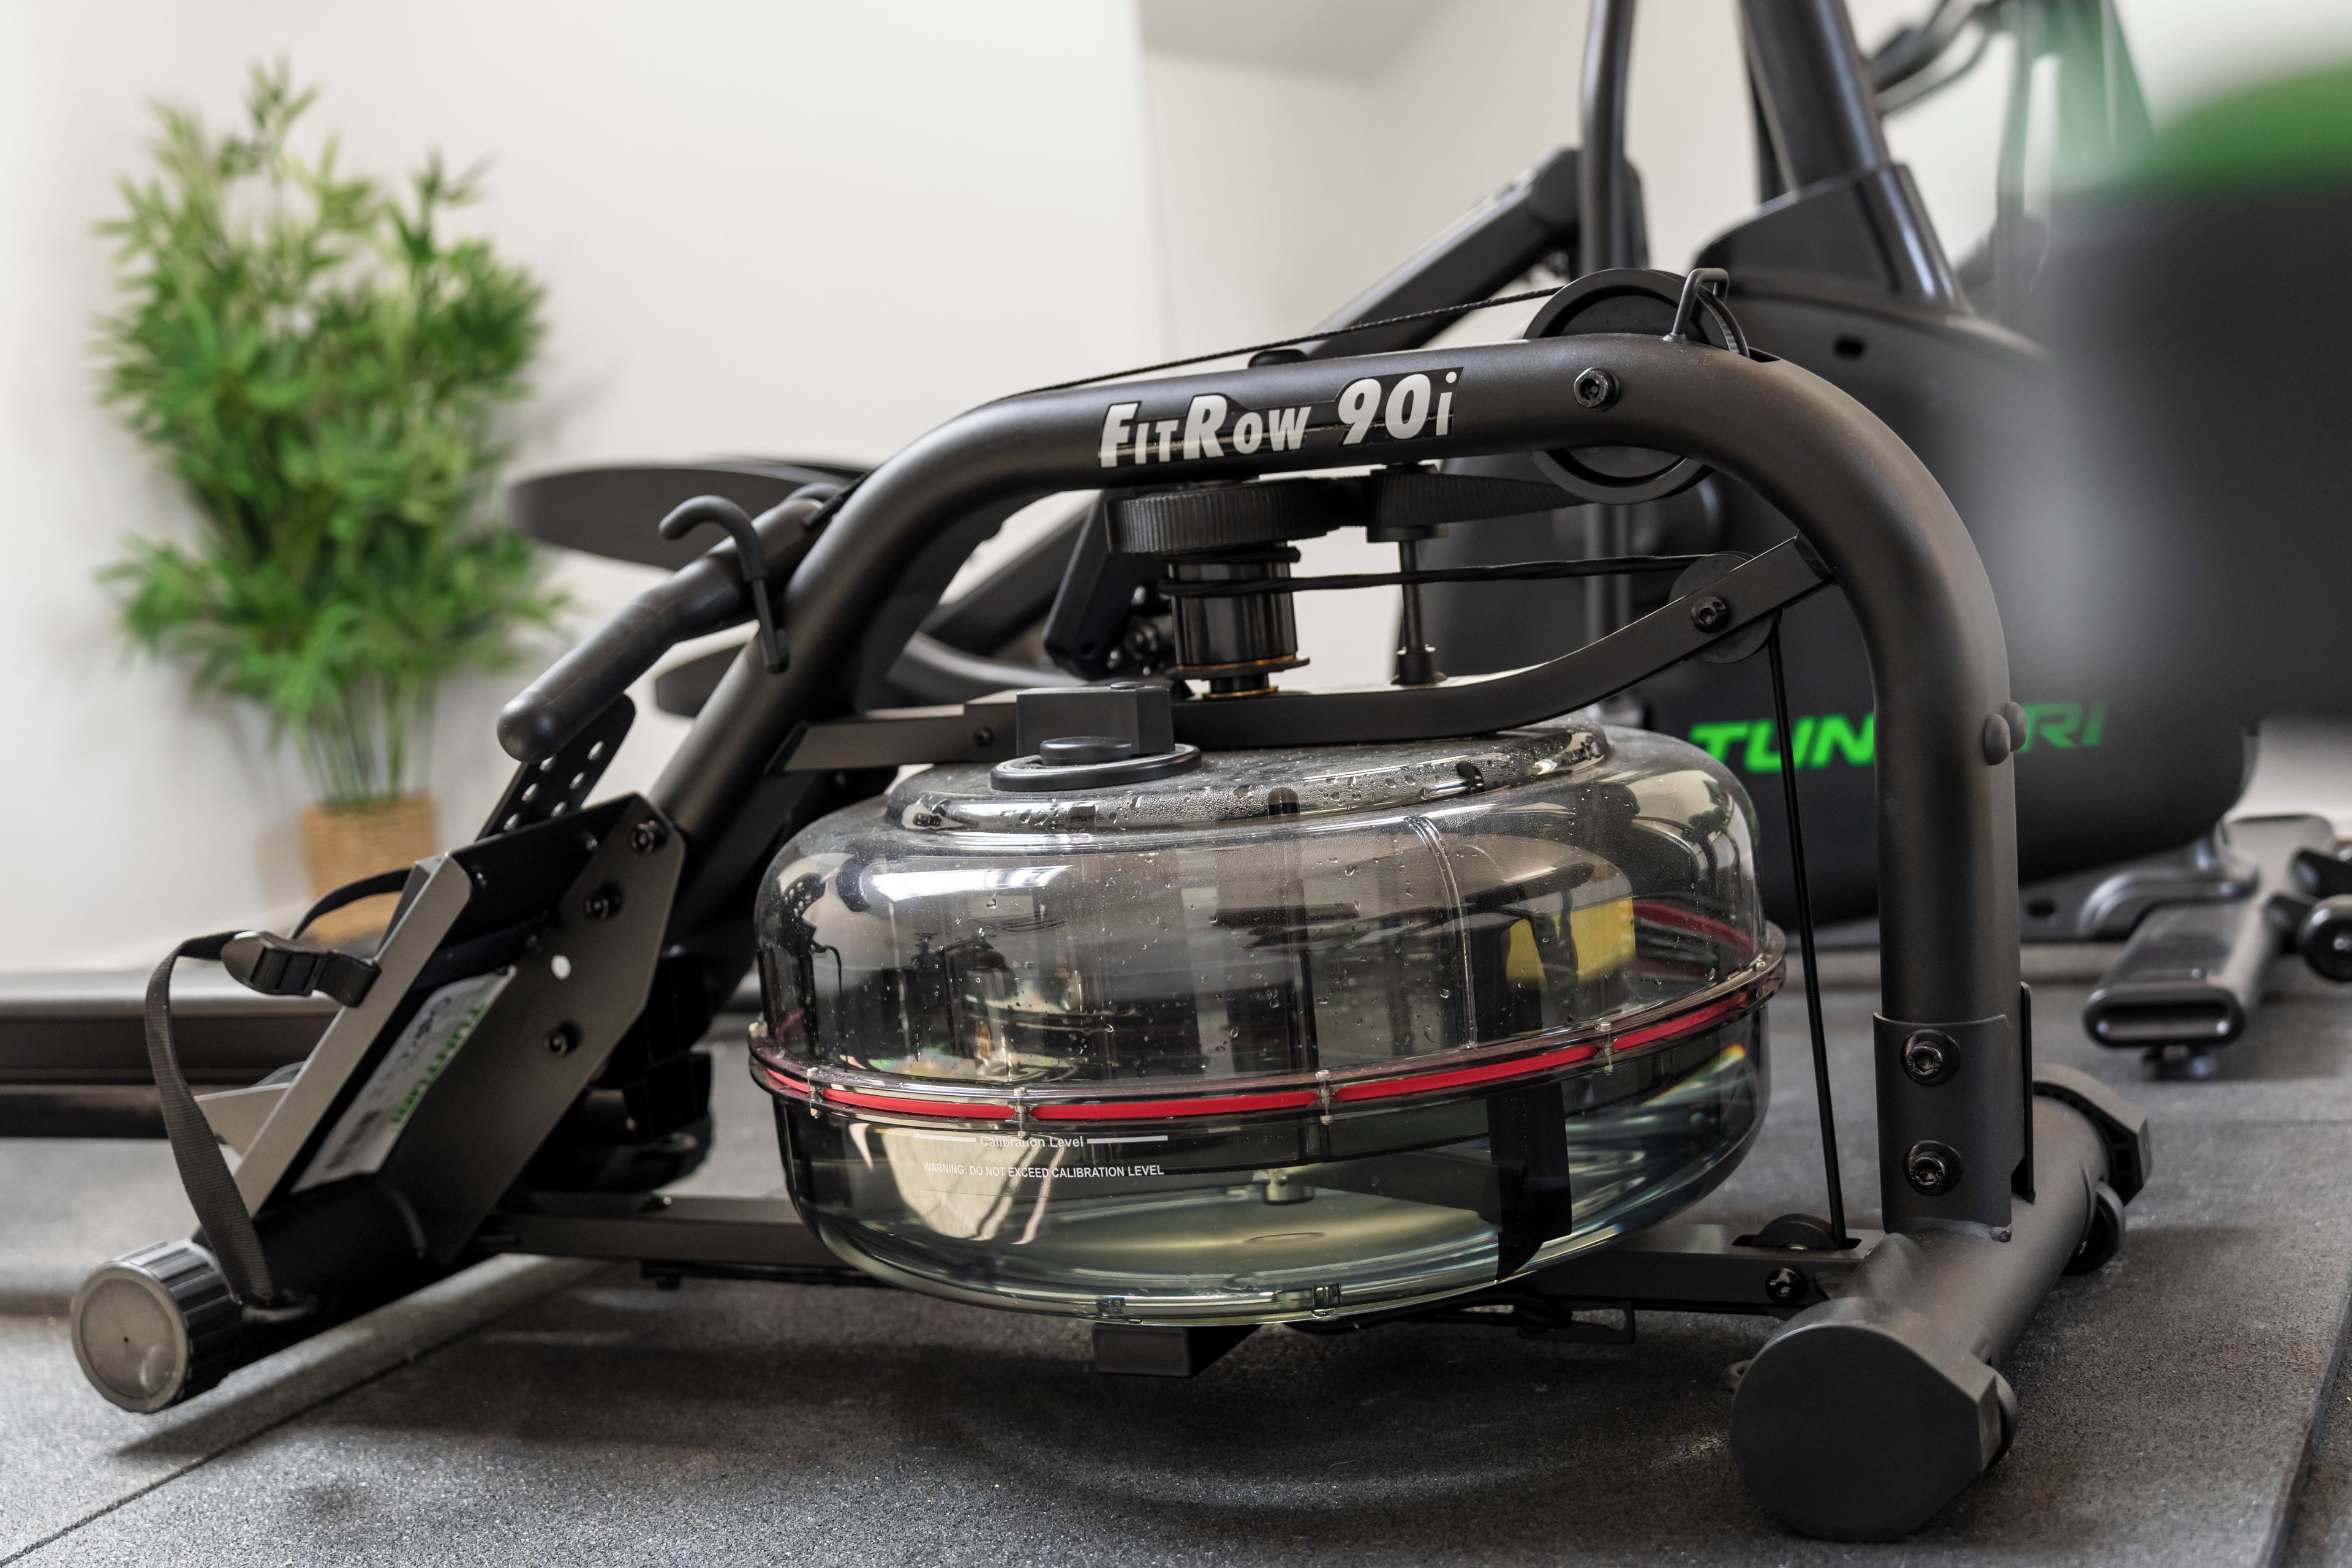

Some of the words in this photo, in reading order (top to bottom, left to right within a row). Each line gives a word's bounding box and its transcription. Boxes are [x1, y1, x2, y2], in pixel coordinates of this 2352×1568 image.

[1338, 371, 1458, 445] 90i
[1688, 698, 2109, 773] TUNRI
[980, 1135, 1046, 1148] Calibration
[1049, 1136, 1084, 1148] Level
[923, 1161, 968, 1175] WARNING:
[970, 1166, 983, 1176] DO
[986, 1166, 1005, 1177] NOT
[1008, 1167, 1049, 1178] EXCEED
[1051, 1166, 1125, 1178] CALIBRATION
[1128, 1164, 1164, 1177] LEVEL
